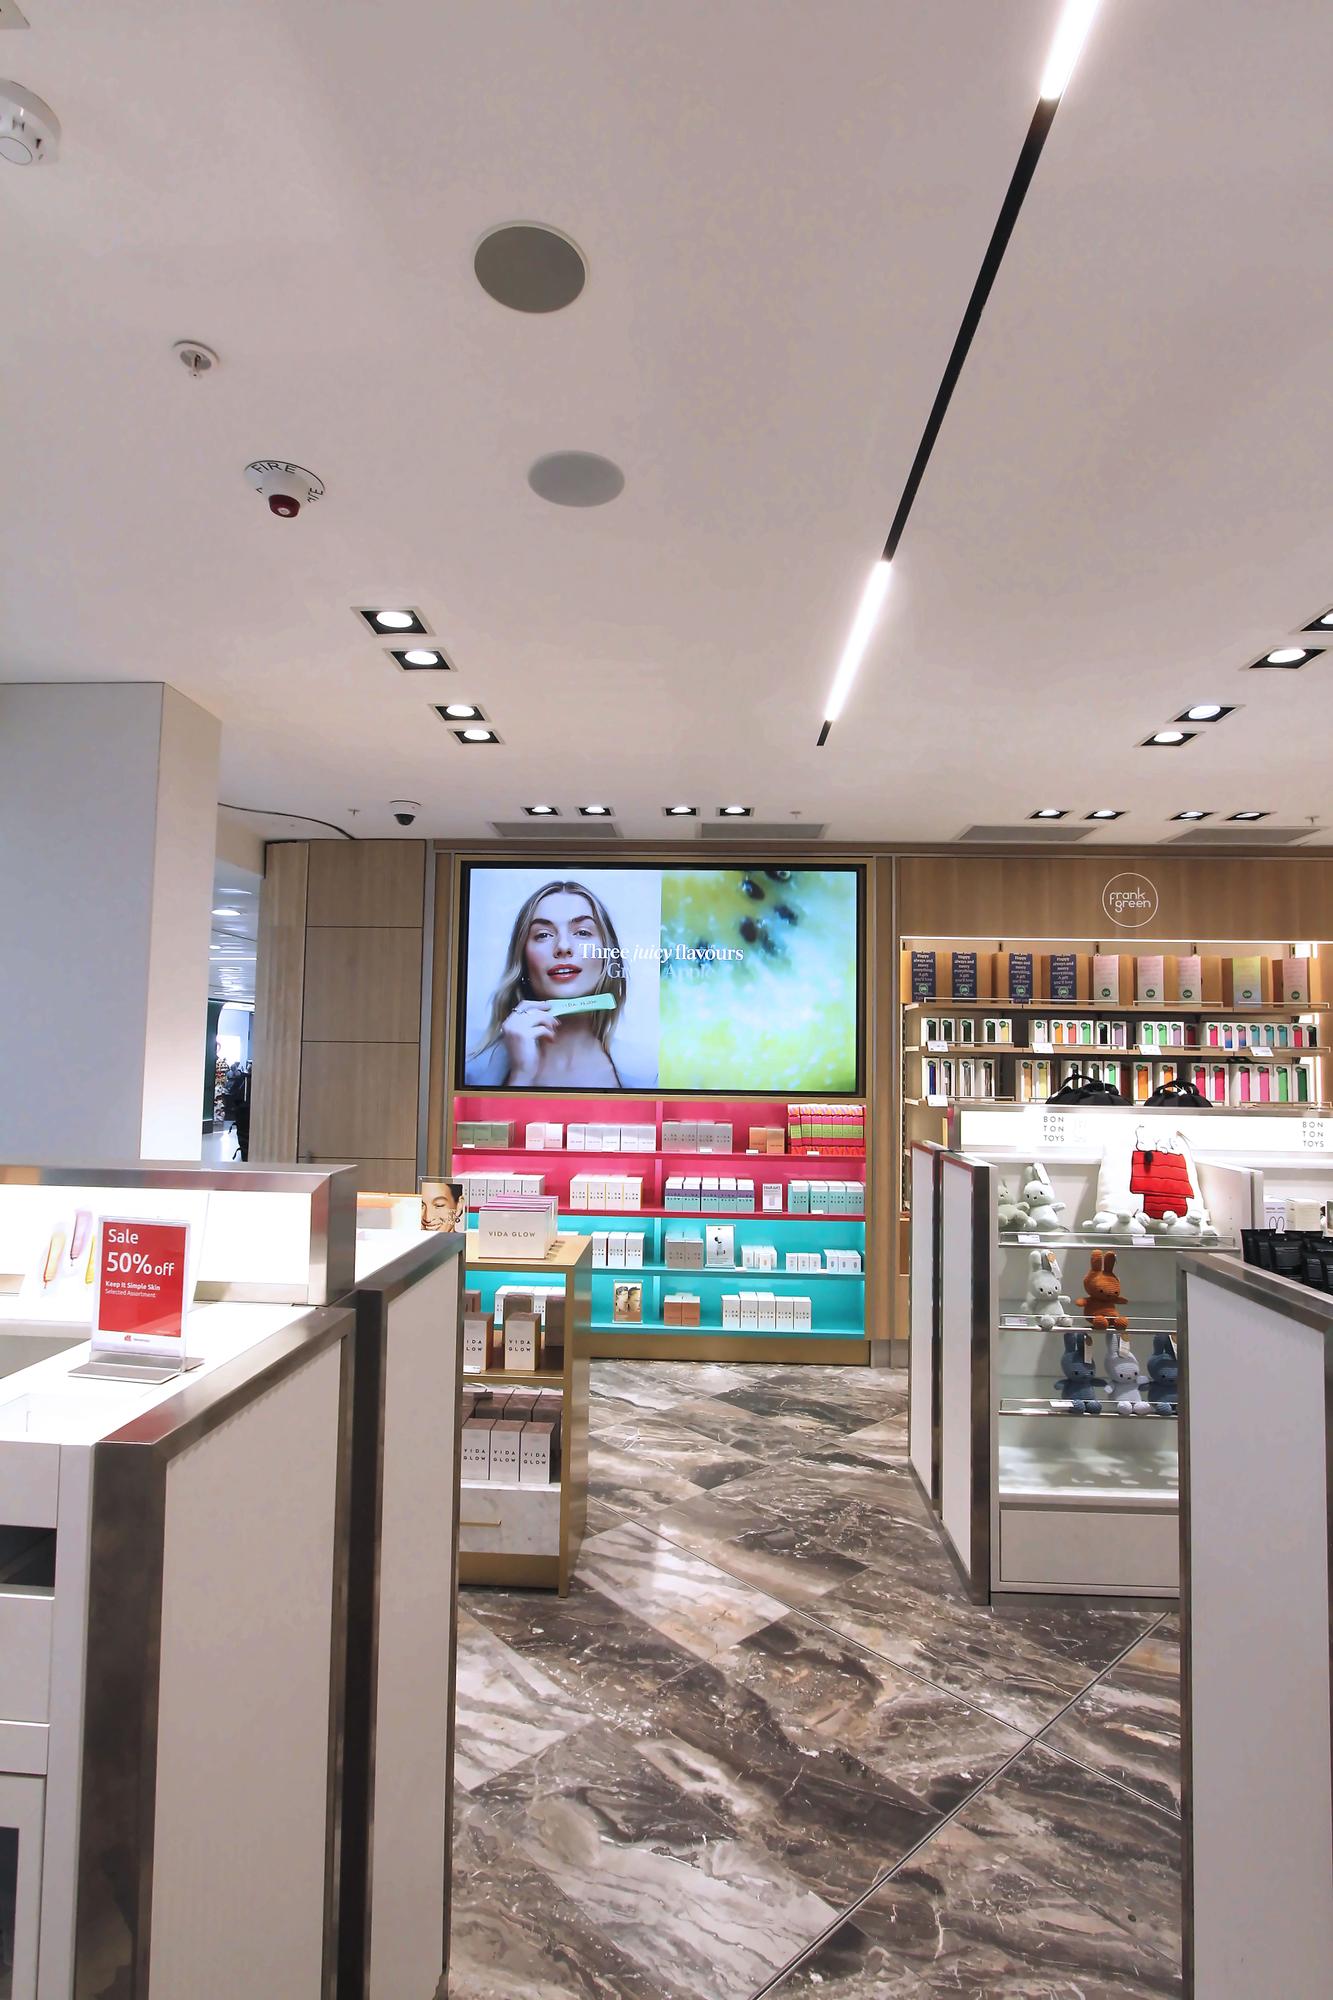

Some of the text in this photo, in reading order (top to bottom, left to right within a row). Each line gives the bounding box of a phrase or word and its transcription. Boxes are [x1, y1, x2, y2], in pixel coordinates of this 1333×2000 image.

[251, 462, 297, 474] FIRE
[1110, 887, 1146, 905] frank
[1114, 900, 1151, 913] green
[579, 943, 744, 963] Three juicy flavours
[108, 1228, 139, 1244] Sale
[106, 1251, 175, 1276] 50% off
[127, 1282, 147, 1291] Simple
